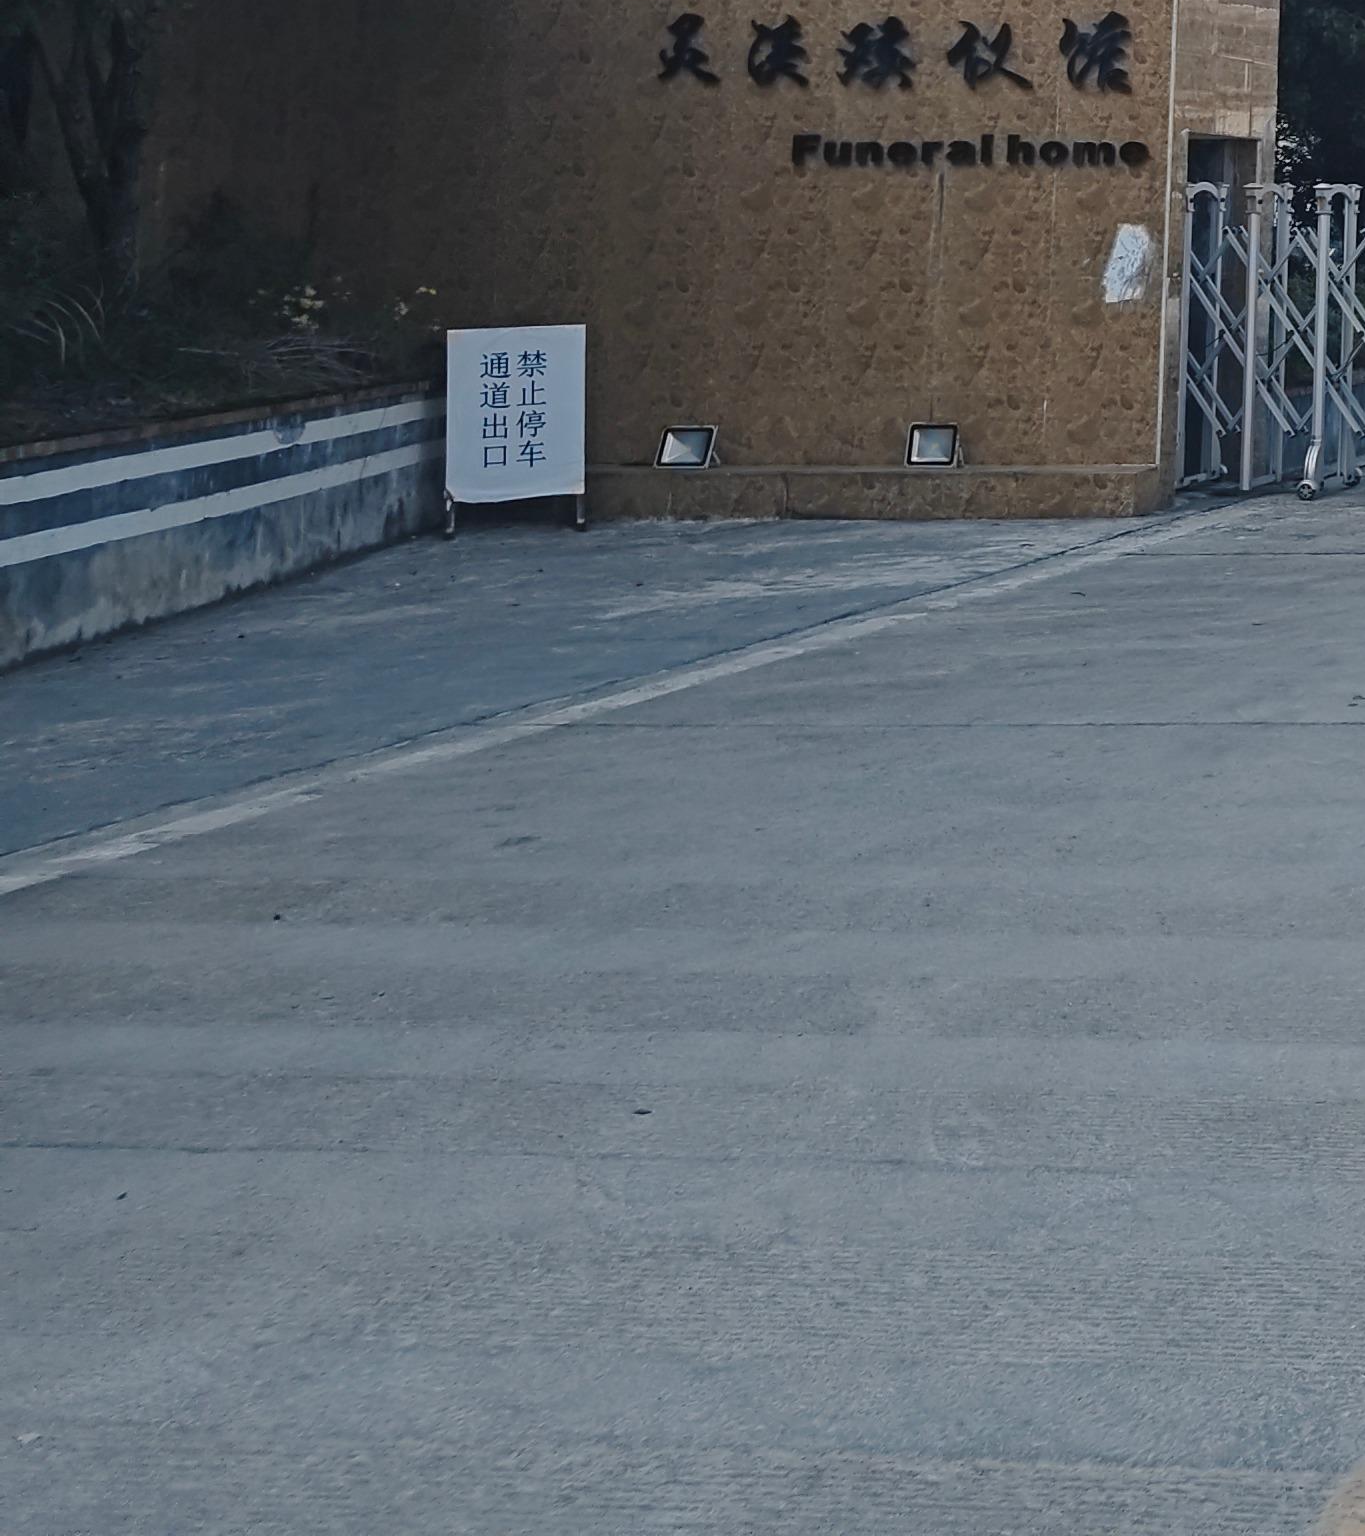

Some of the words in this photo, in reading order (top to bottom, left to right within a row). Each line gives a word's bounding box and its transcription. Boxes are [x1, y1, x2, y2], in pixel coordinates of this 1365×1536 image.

[791, 133, 995, 167] Funeral
[1006, 133, 1151, 167] home
[479, 351, 512, 469] 通道出口
[516, 349, 548, 469] 禁止停车
